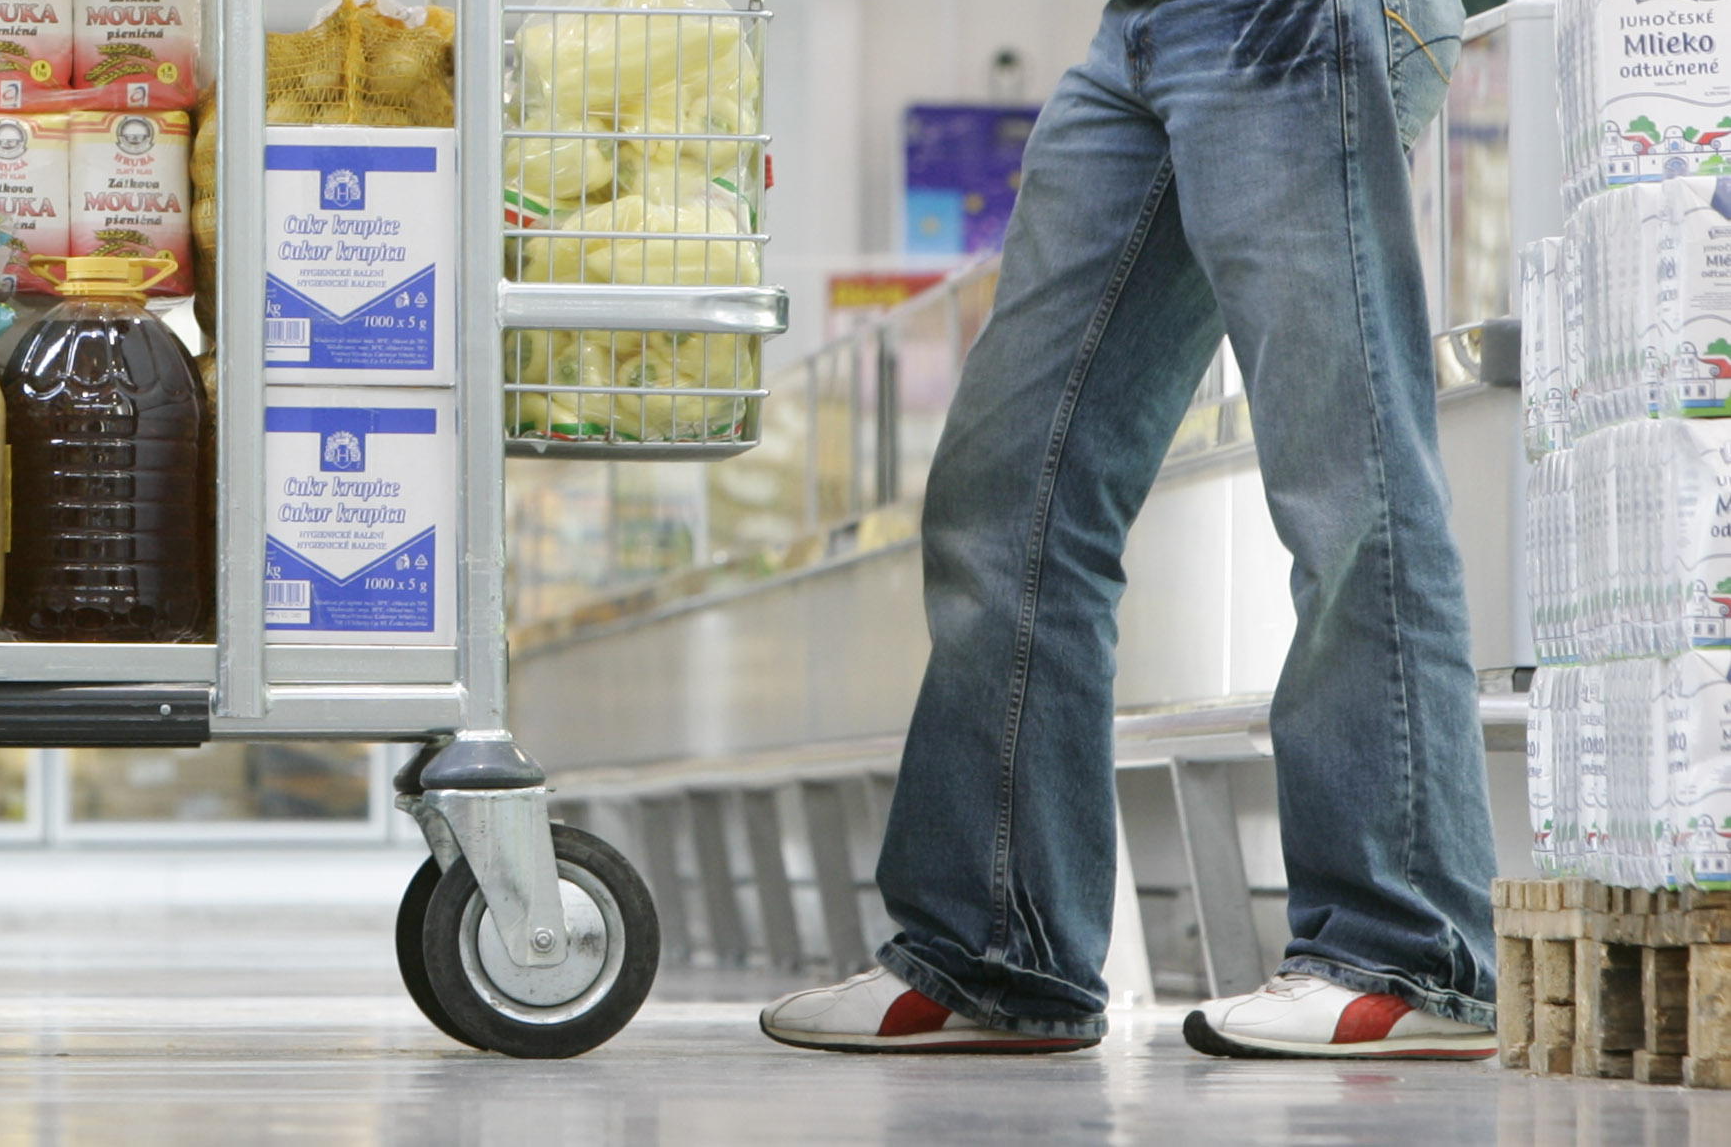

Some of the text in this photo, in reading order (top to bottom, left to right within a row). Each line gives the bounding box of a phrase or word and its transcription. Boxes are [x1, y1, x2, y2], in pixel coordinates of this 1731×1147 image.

[86, 6, 182, 26] MOUKA
[1620, 8, 1715, 30] JUHOČESKÉ
[1624, 31, 1716, 57] Mlieko
[1619, 58, 1720, 79] odtučnené
[108, 178, 160, 189] Zátkova
[84, 191, 181, 213] MOUKA
[284, 215, 400, 240] Cukr krupice
[278, 240, 406, 266] Cukor krupica
[363, 315, 394, 328] 1000
[408, 316, 415, 328] 5
[284, 476, 400, 502] Cukr krupice
[278, 502, 406, 528] Cukor krupica
[364, 578, 394, 591] 1000
[408, 578, 415, 591] 5
